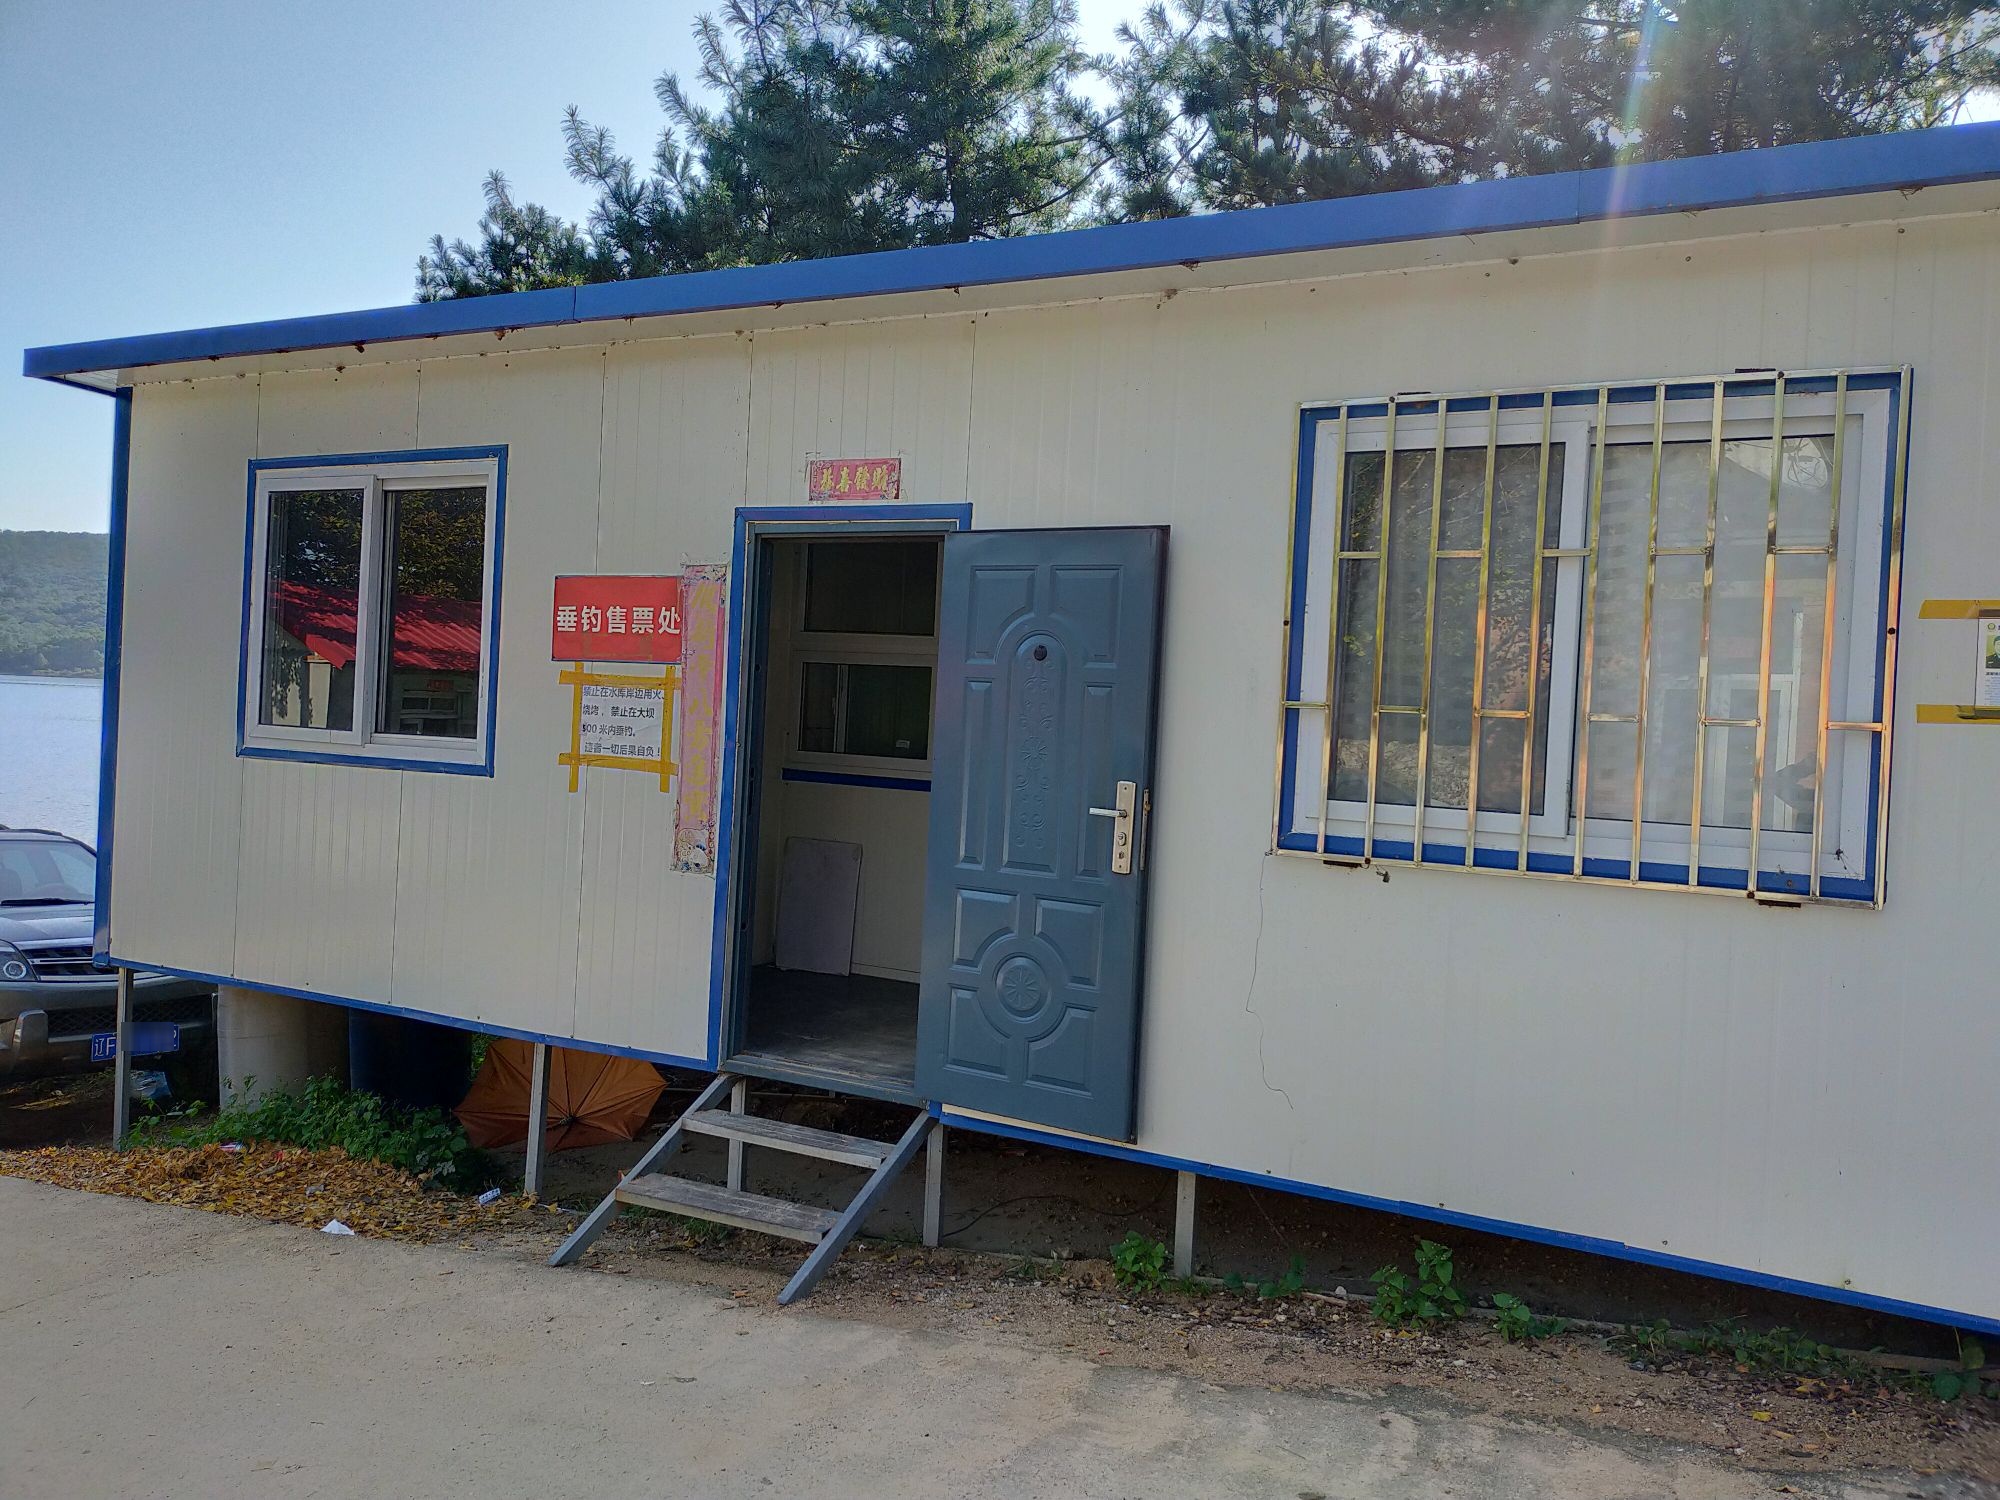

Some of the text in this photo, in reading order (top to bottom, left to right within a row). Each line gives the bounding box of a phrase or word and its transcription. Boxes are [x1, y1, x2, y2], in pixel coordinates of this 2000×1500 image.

[556, 605, 681, 635] 垂钓售票处
